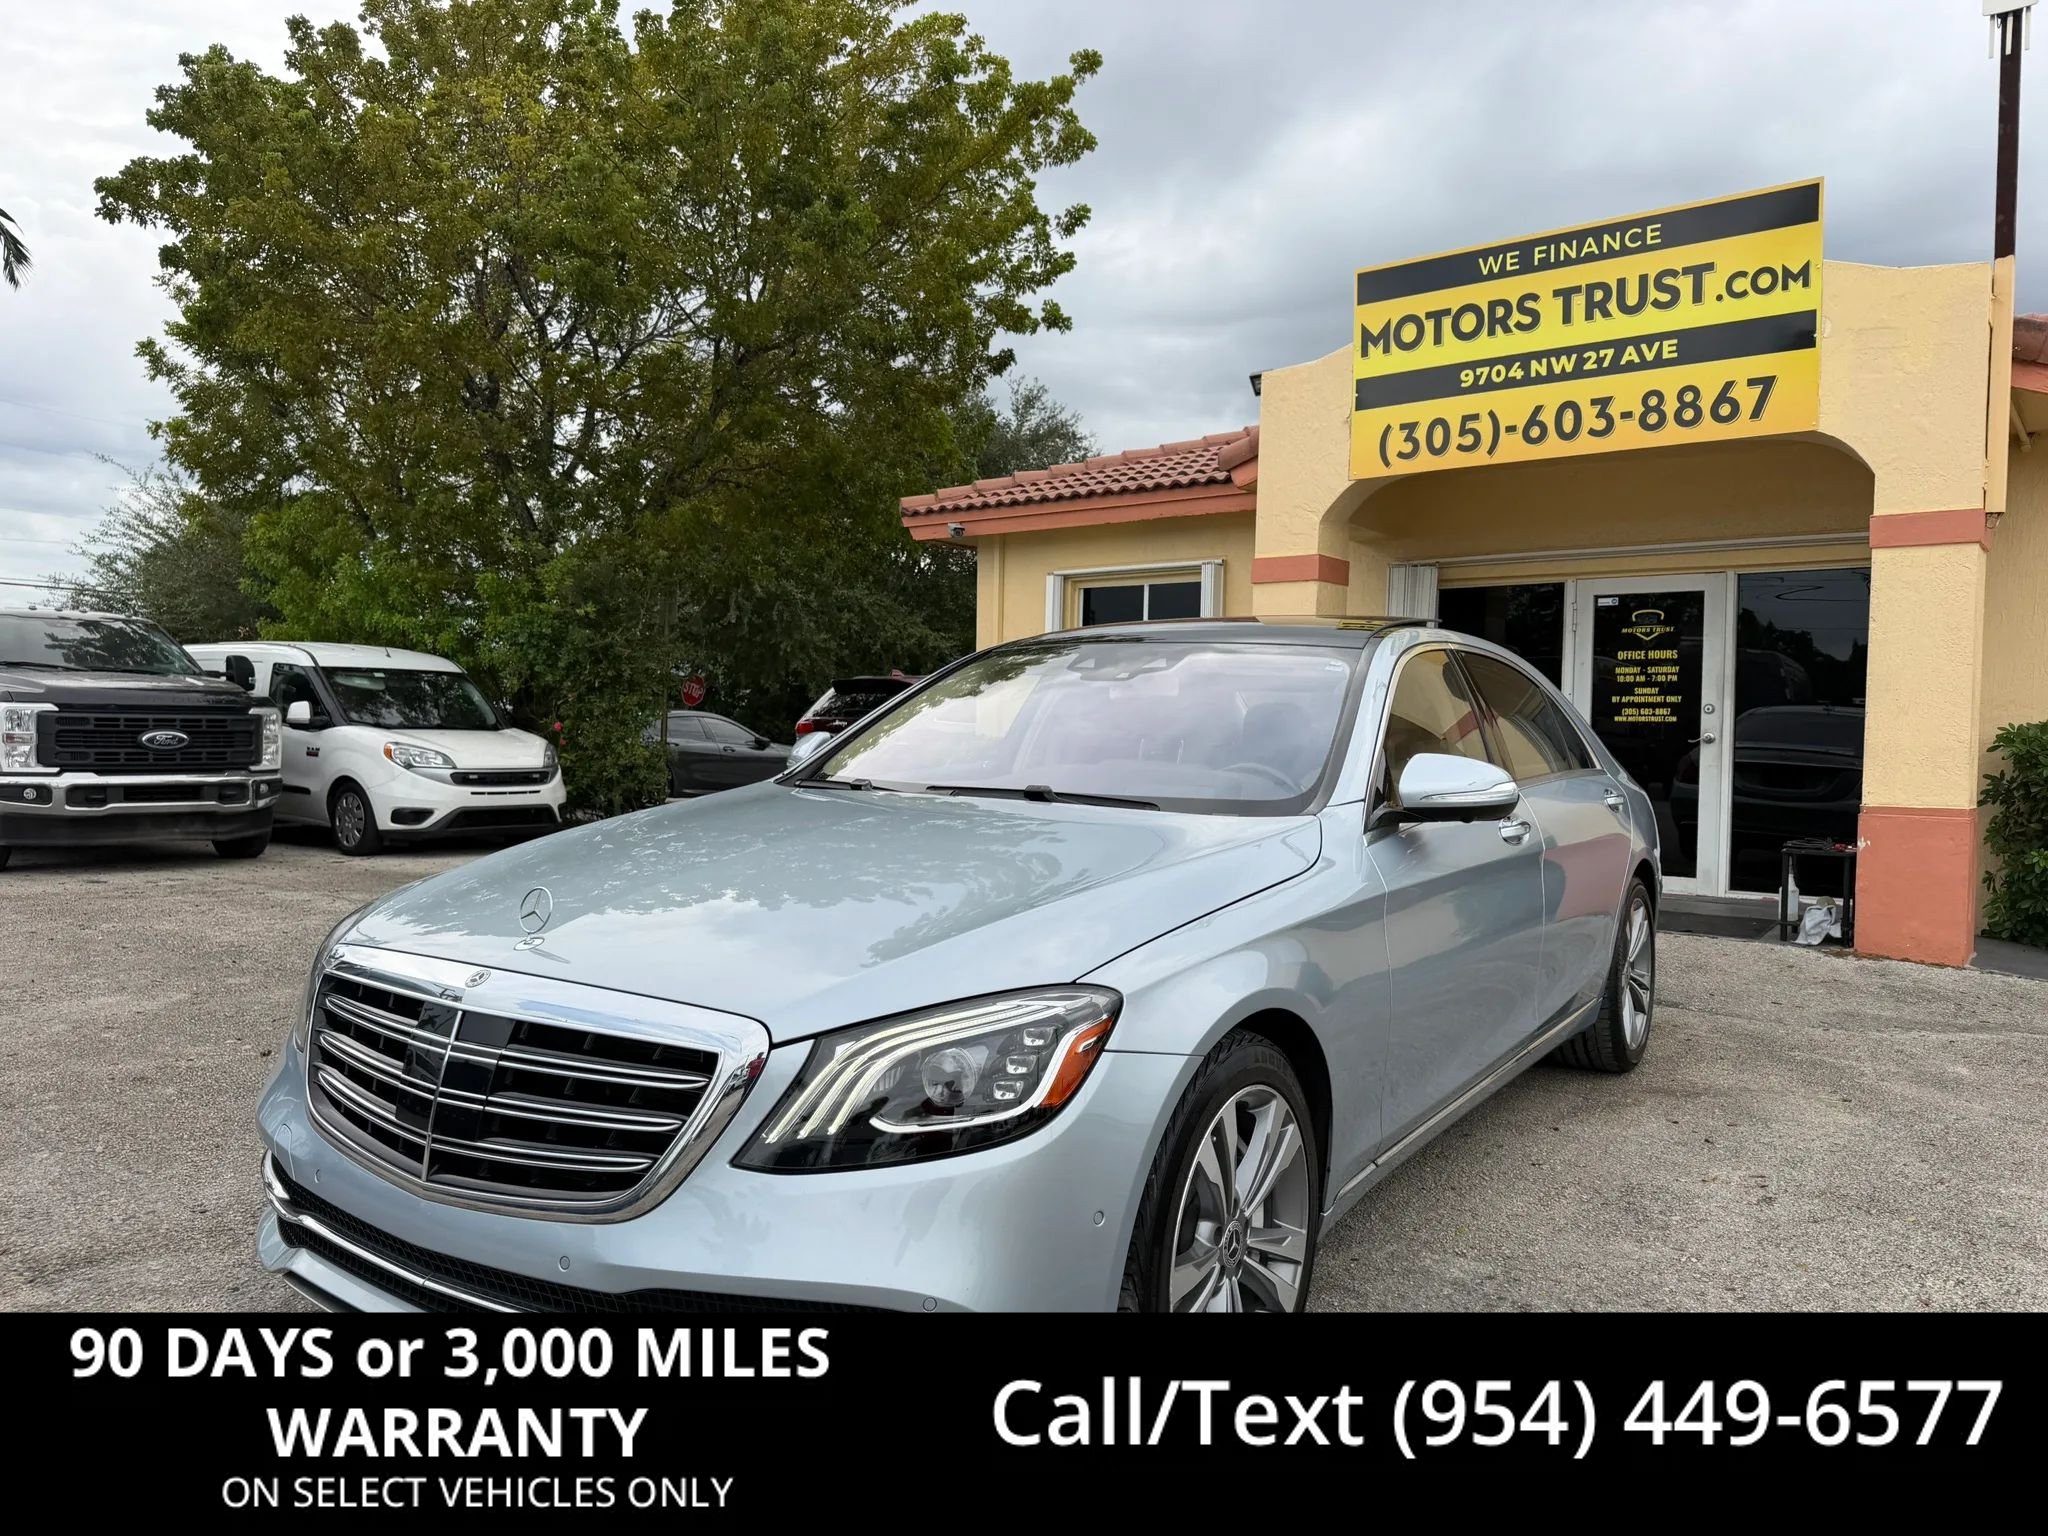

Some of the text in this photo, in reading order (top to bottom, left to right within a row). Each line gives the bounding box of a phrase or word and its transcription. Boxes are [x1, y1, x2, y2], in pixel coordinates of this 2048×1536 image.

[1478, 223, 1662, 276] WE FINANCE
[1360, 292, 1542, 360] MOTORS
[1459, 338, 1679, 388] 9704 NW 27 AVE
[1379, 375, 1779, 469] (305)-603-8867
[1617, 649, 1679, 660] OFFICE HOURS
[1615, 666, 1641, 674] MONDAY
[1647, 666, 1680, 674] SATURDAY
[1616, 675, 1635, 683] 10:00
[1667, 674, 1678, 682] PM
[683, 680, 704, 698] STOP
[1634, 687, 1659, 695] SUNDAY
[1621, 695, 1665, 703] APPOINTMENT
[1666, 695, 1682, 703] ONLY
[154, 734, 179, 745] Ford
